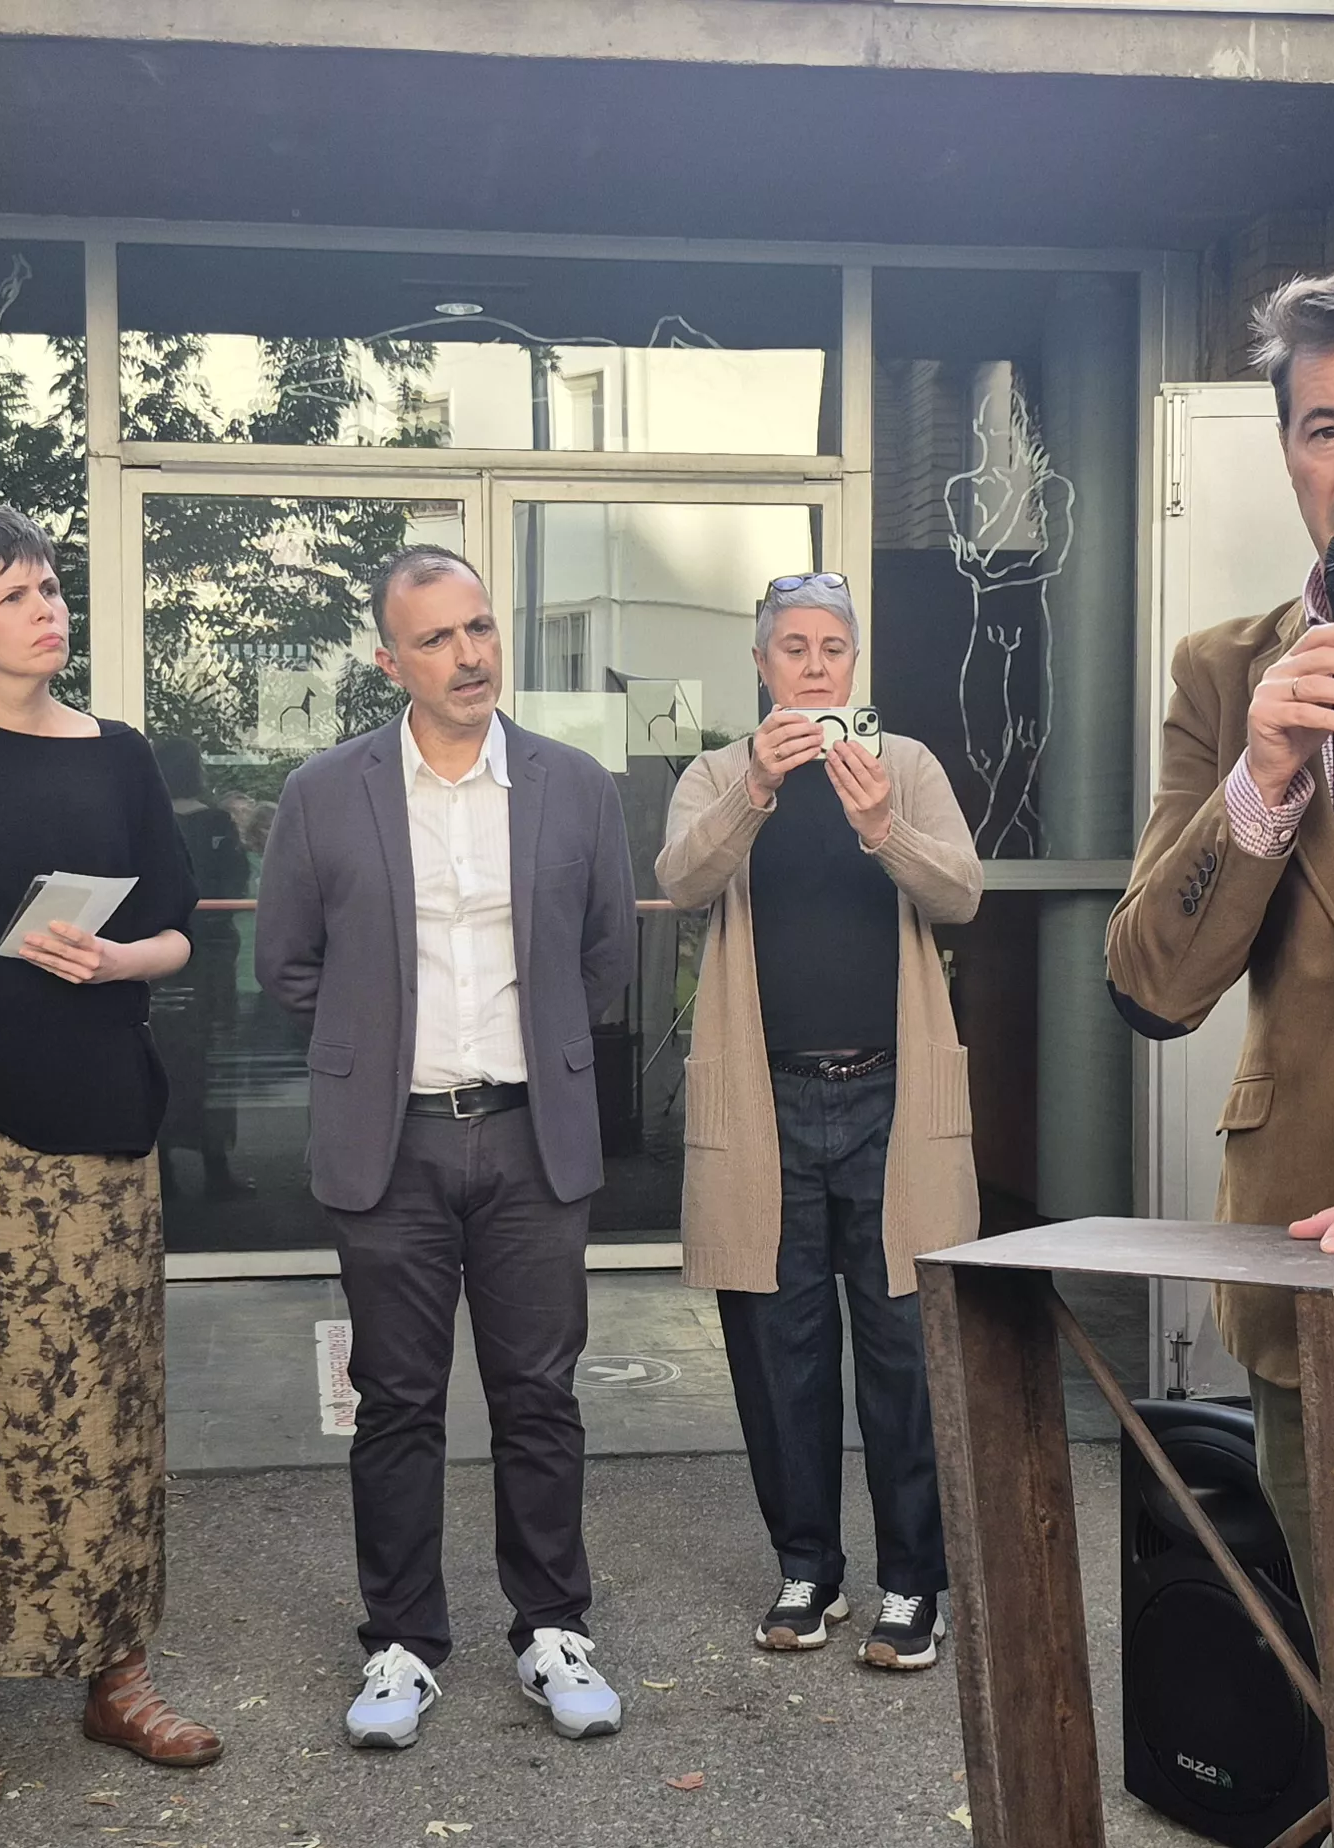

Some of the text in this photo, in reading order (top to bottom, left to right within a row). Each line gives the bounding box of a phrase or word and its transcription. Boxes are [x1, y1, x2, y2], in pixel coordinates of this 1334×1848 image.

[328, 1326, 346, 1338] POR
[329, 1340, 348, 1360] FAVOR
[331, 1361, 351, 1388] ESPERE
[332, 1388, 353, 1398] SU
[1177, 1752, 1217, 1778] ibiza
